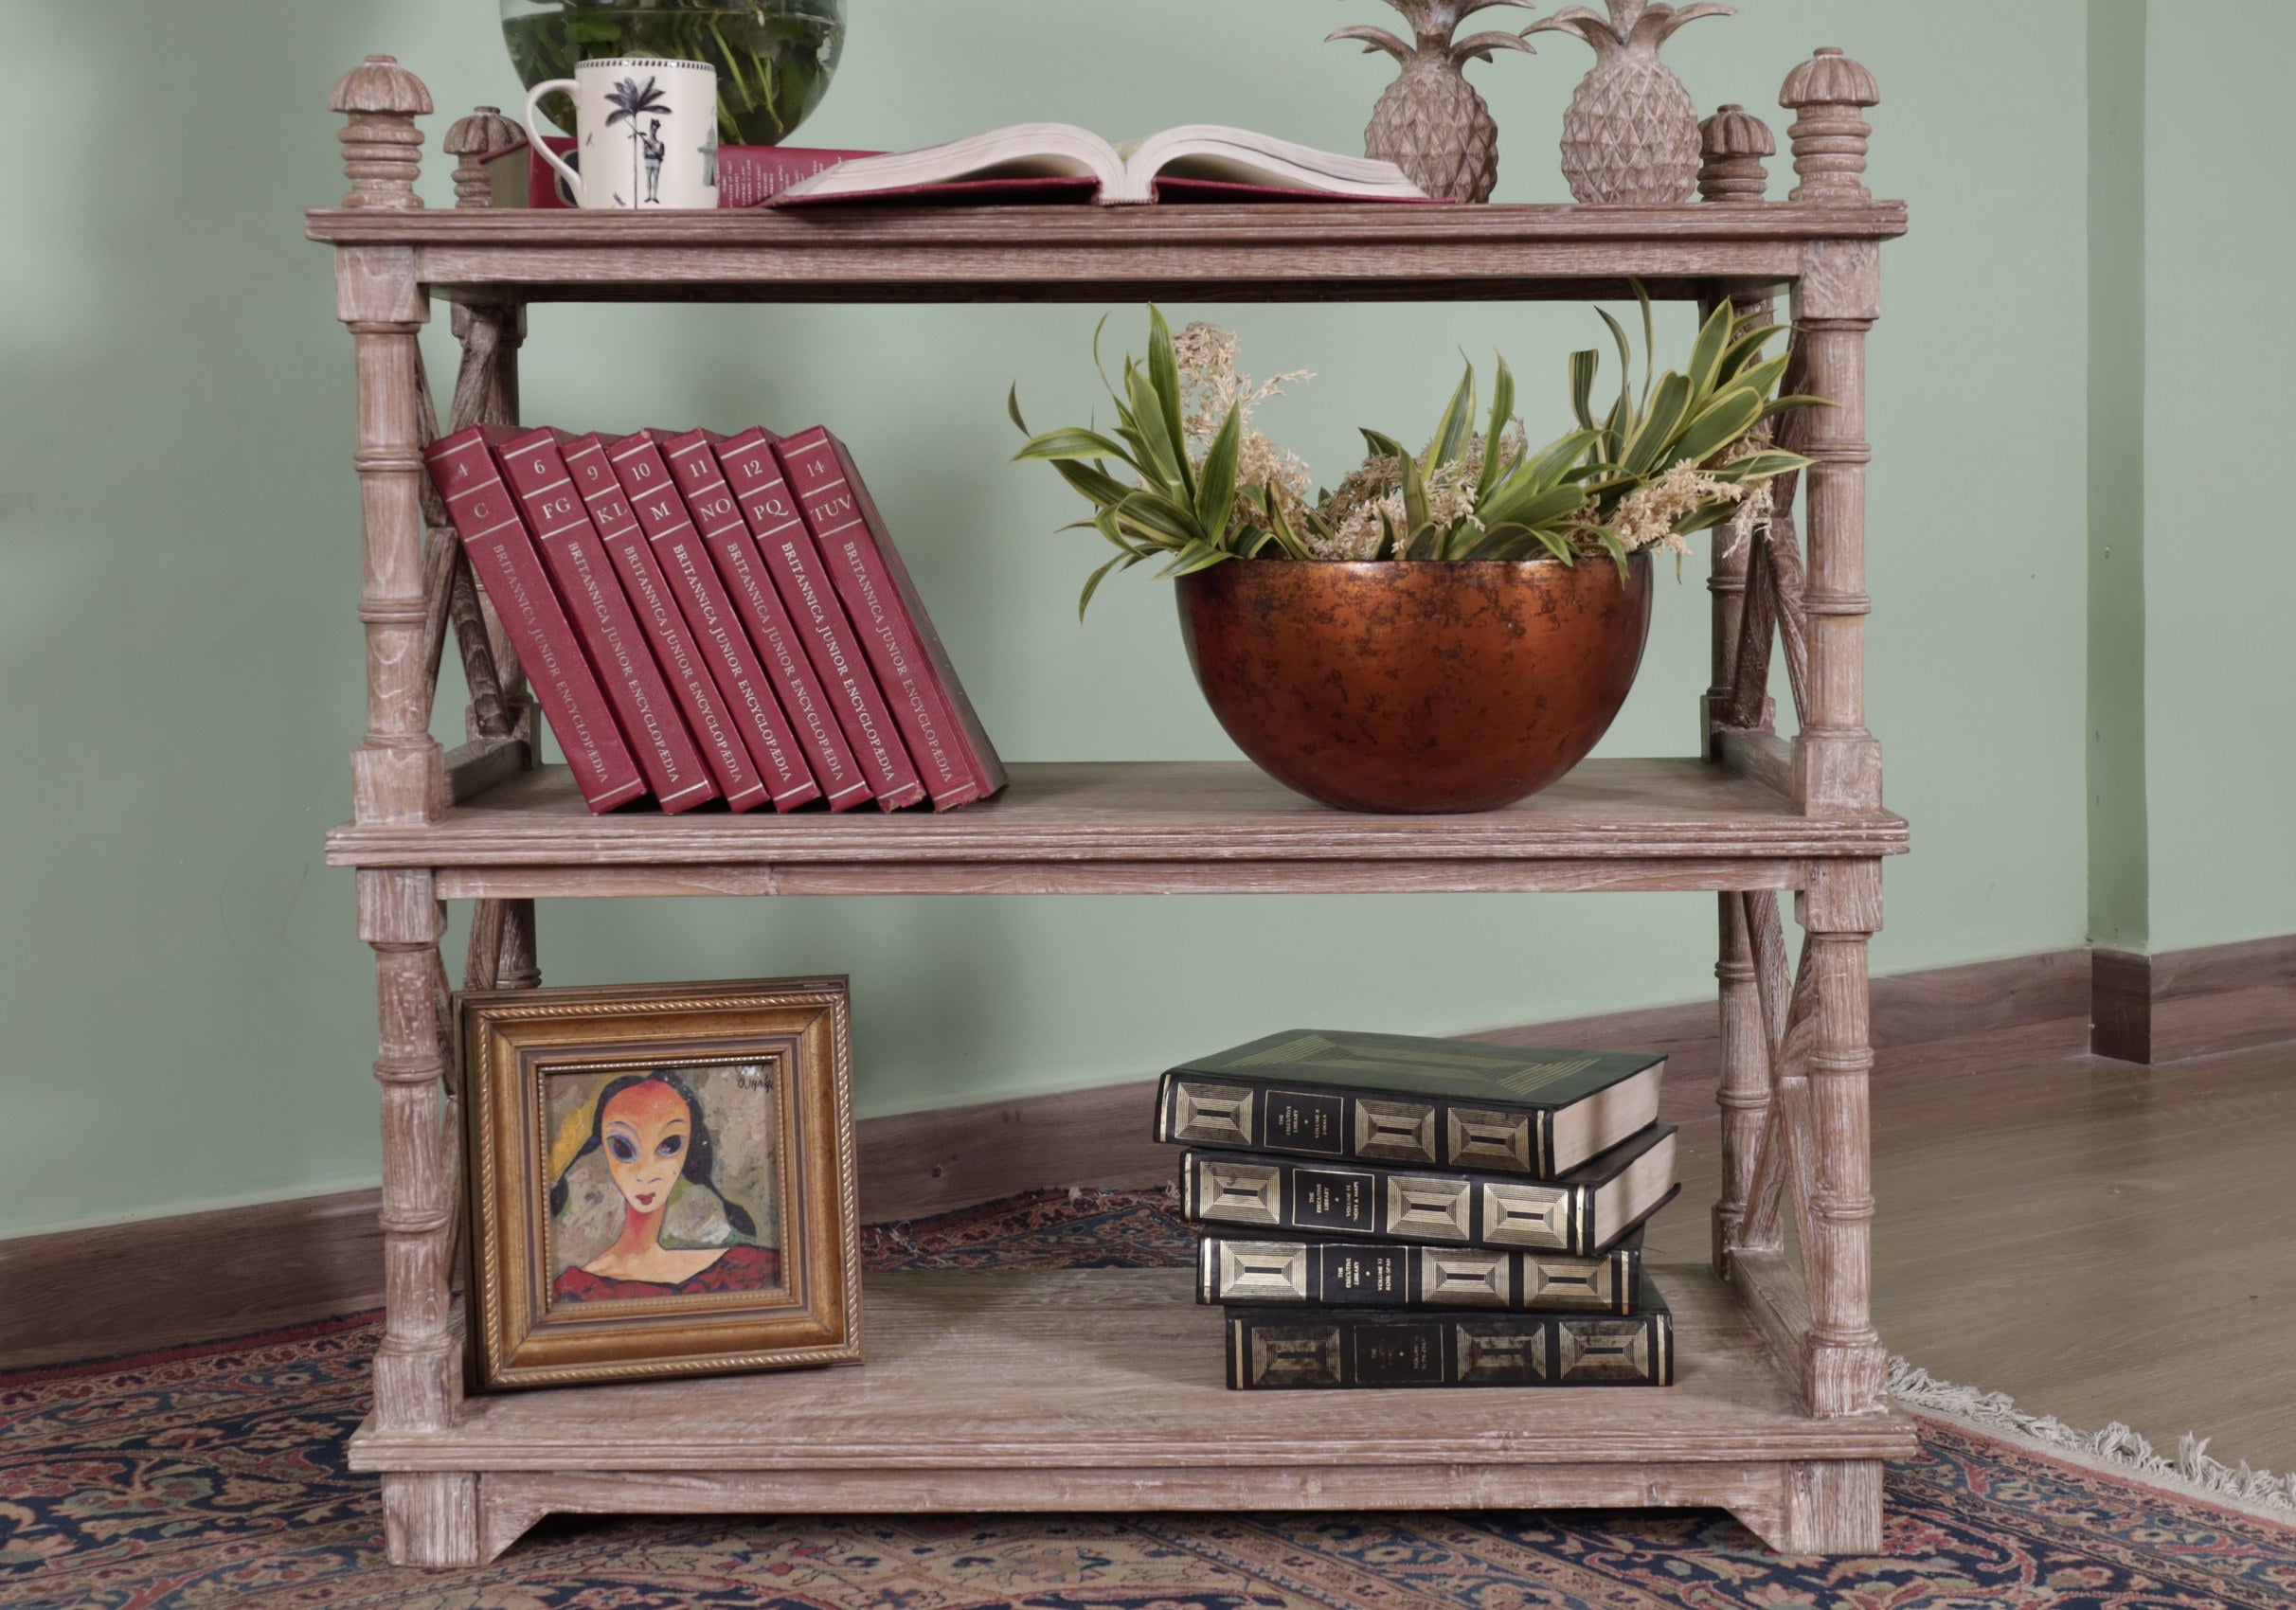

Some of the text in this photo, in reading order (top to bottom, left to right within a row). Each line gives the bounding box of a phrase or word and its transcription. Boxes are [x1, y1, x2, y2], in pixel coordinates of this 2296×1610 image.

[533, 459, 546, 474] 6
[587, 466, 599, 480] 9
[632, 462, 651, 481] 10
[689, 460, 709, 478] 11
[742, 459, 762, 478] 12
[806, 459, 825, 477] 14
[474, 503, 489, 518] C
[542, 497, 571, 519] FG
[650, 502, 671, 521] M
[699, 497, 731, 521] NO
[753, 498, 789, 521] PQ
[810, 494, 852, 522] TUV
[493, 544, 536, 627] BRITANNICA
[527, 624, 561, 678] JUNIOR
[568, 542, 610, 624] BRITANNICA
[601, 623, 634, 677] JUNIOR
[624, 546, 668, 627] BRITANNICA
[659, 628, 693, 678] JUNIOR
[673, 544, 717, 625] BRITANNICA
[709, 627, 743, 677] JUNIOR
[727, 542, 771, 624] BRITANNICA
[762, 626, 796, 676] JUNIOR
[781, 542, 825, 623] BRITANNICA
[816, 625, 848, 676] JUNIOR
[843, 542, 885, 623] BRITANNICA
[875, 624, 907, 676] JUNIOR
